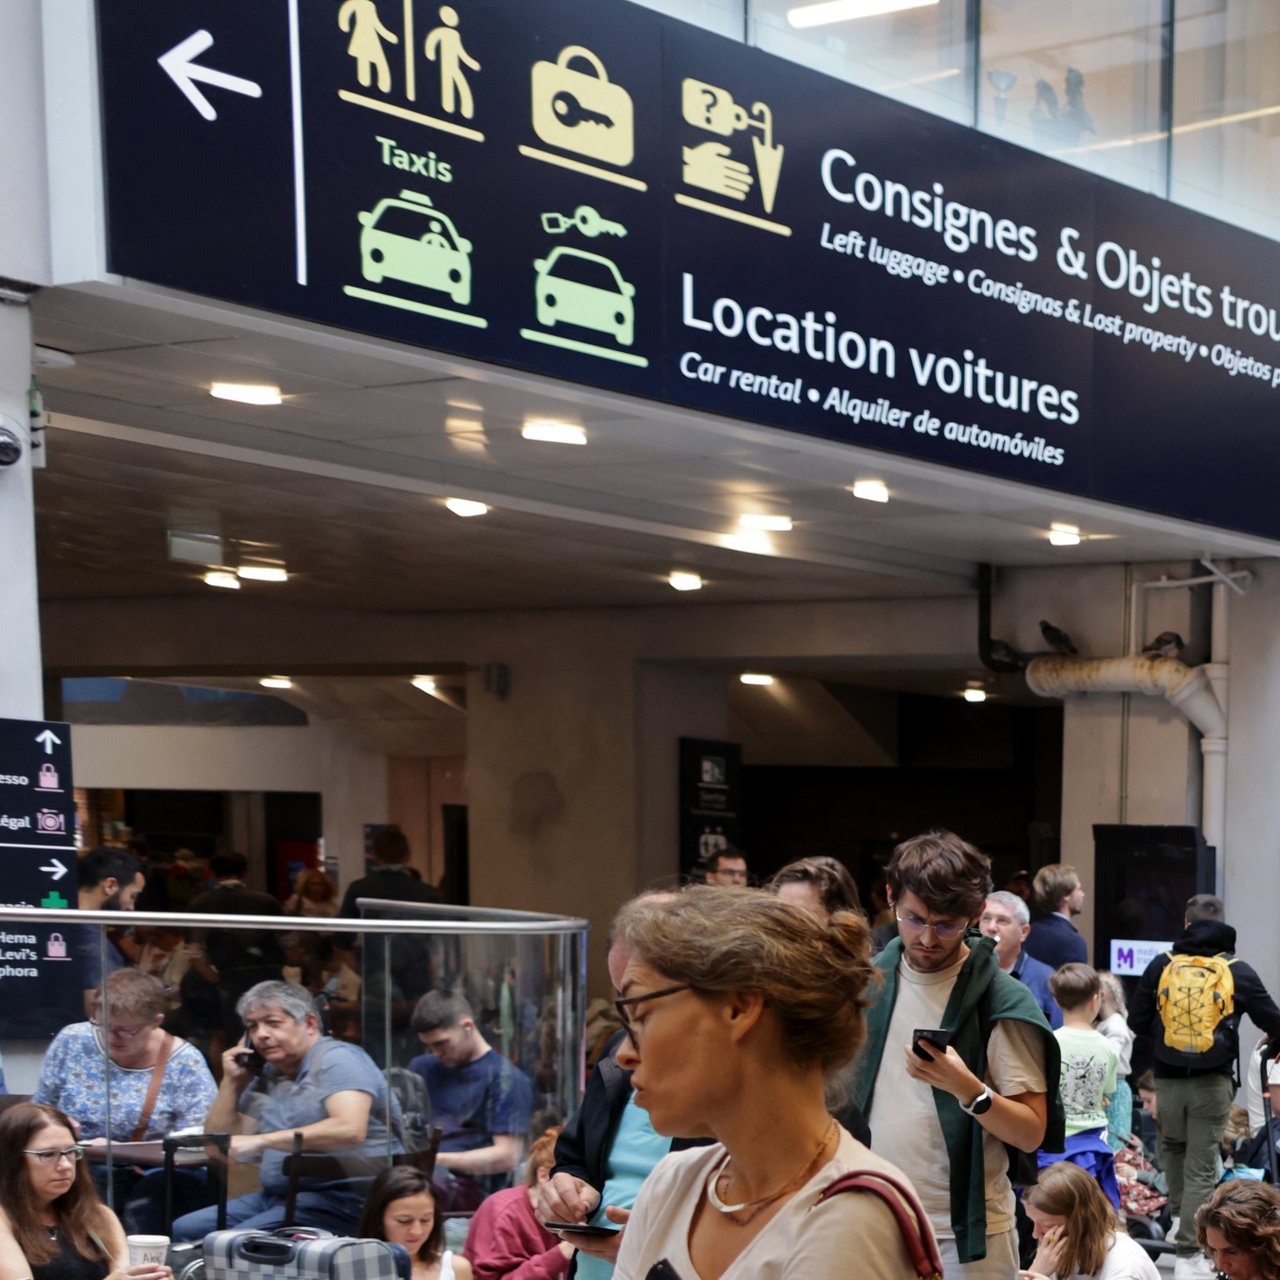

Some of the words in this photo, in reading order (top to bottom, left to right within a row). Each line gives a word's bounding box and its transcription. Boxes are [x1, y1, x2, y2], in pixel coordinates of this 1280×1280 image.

[375, 136, 453, 184] Taxis
[820, 148, 1038, 261] Consignes
[1056, 227, 1088, 281] &
[1097, 241, 1213, 319] Objets
[681, 272, 896, 379] Location
[909, 346, 1080, 426] voitures
[820, 223, 865, 260] Left
[868, 234, 950, 286] luggage
[967, 268, 1064, 323] Consignas
[1065, 299, 1081, 323] &
[1083, 304, 1123, 336] Lost
[1123, 318, 1197, 360] property
[1210, 343, 1270, 383] Objetos
[680, 351, 727, 386] Car
[729, 362, 802, 405] rental
[823, 387, 907, 430] Alquiler
[913, 407, 941, 437] de
[943, 412, 1065, 466] automóviles
